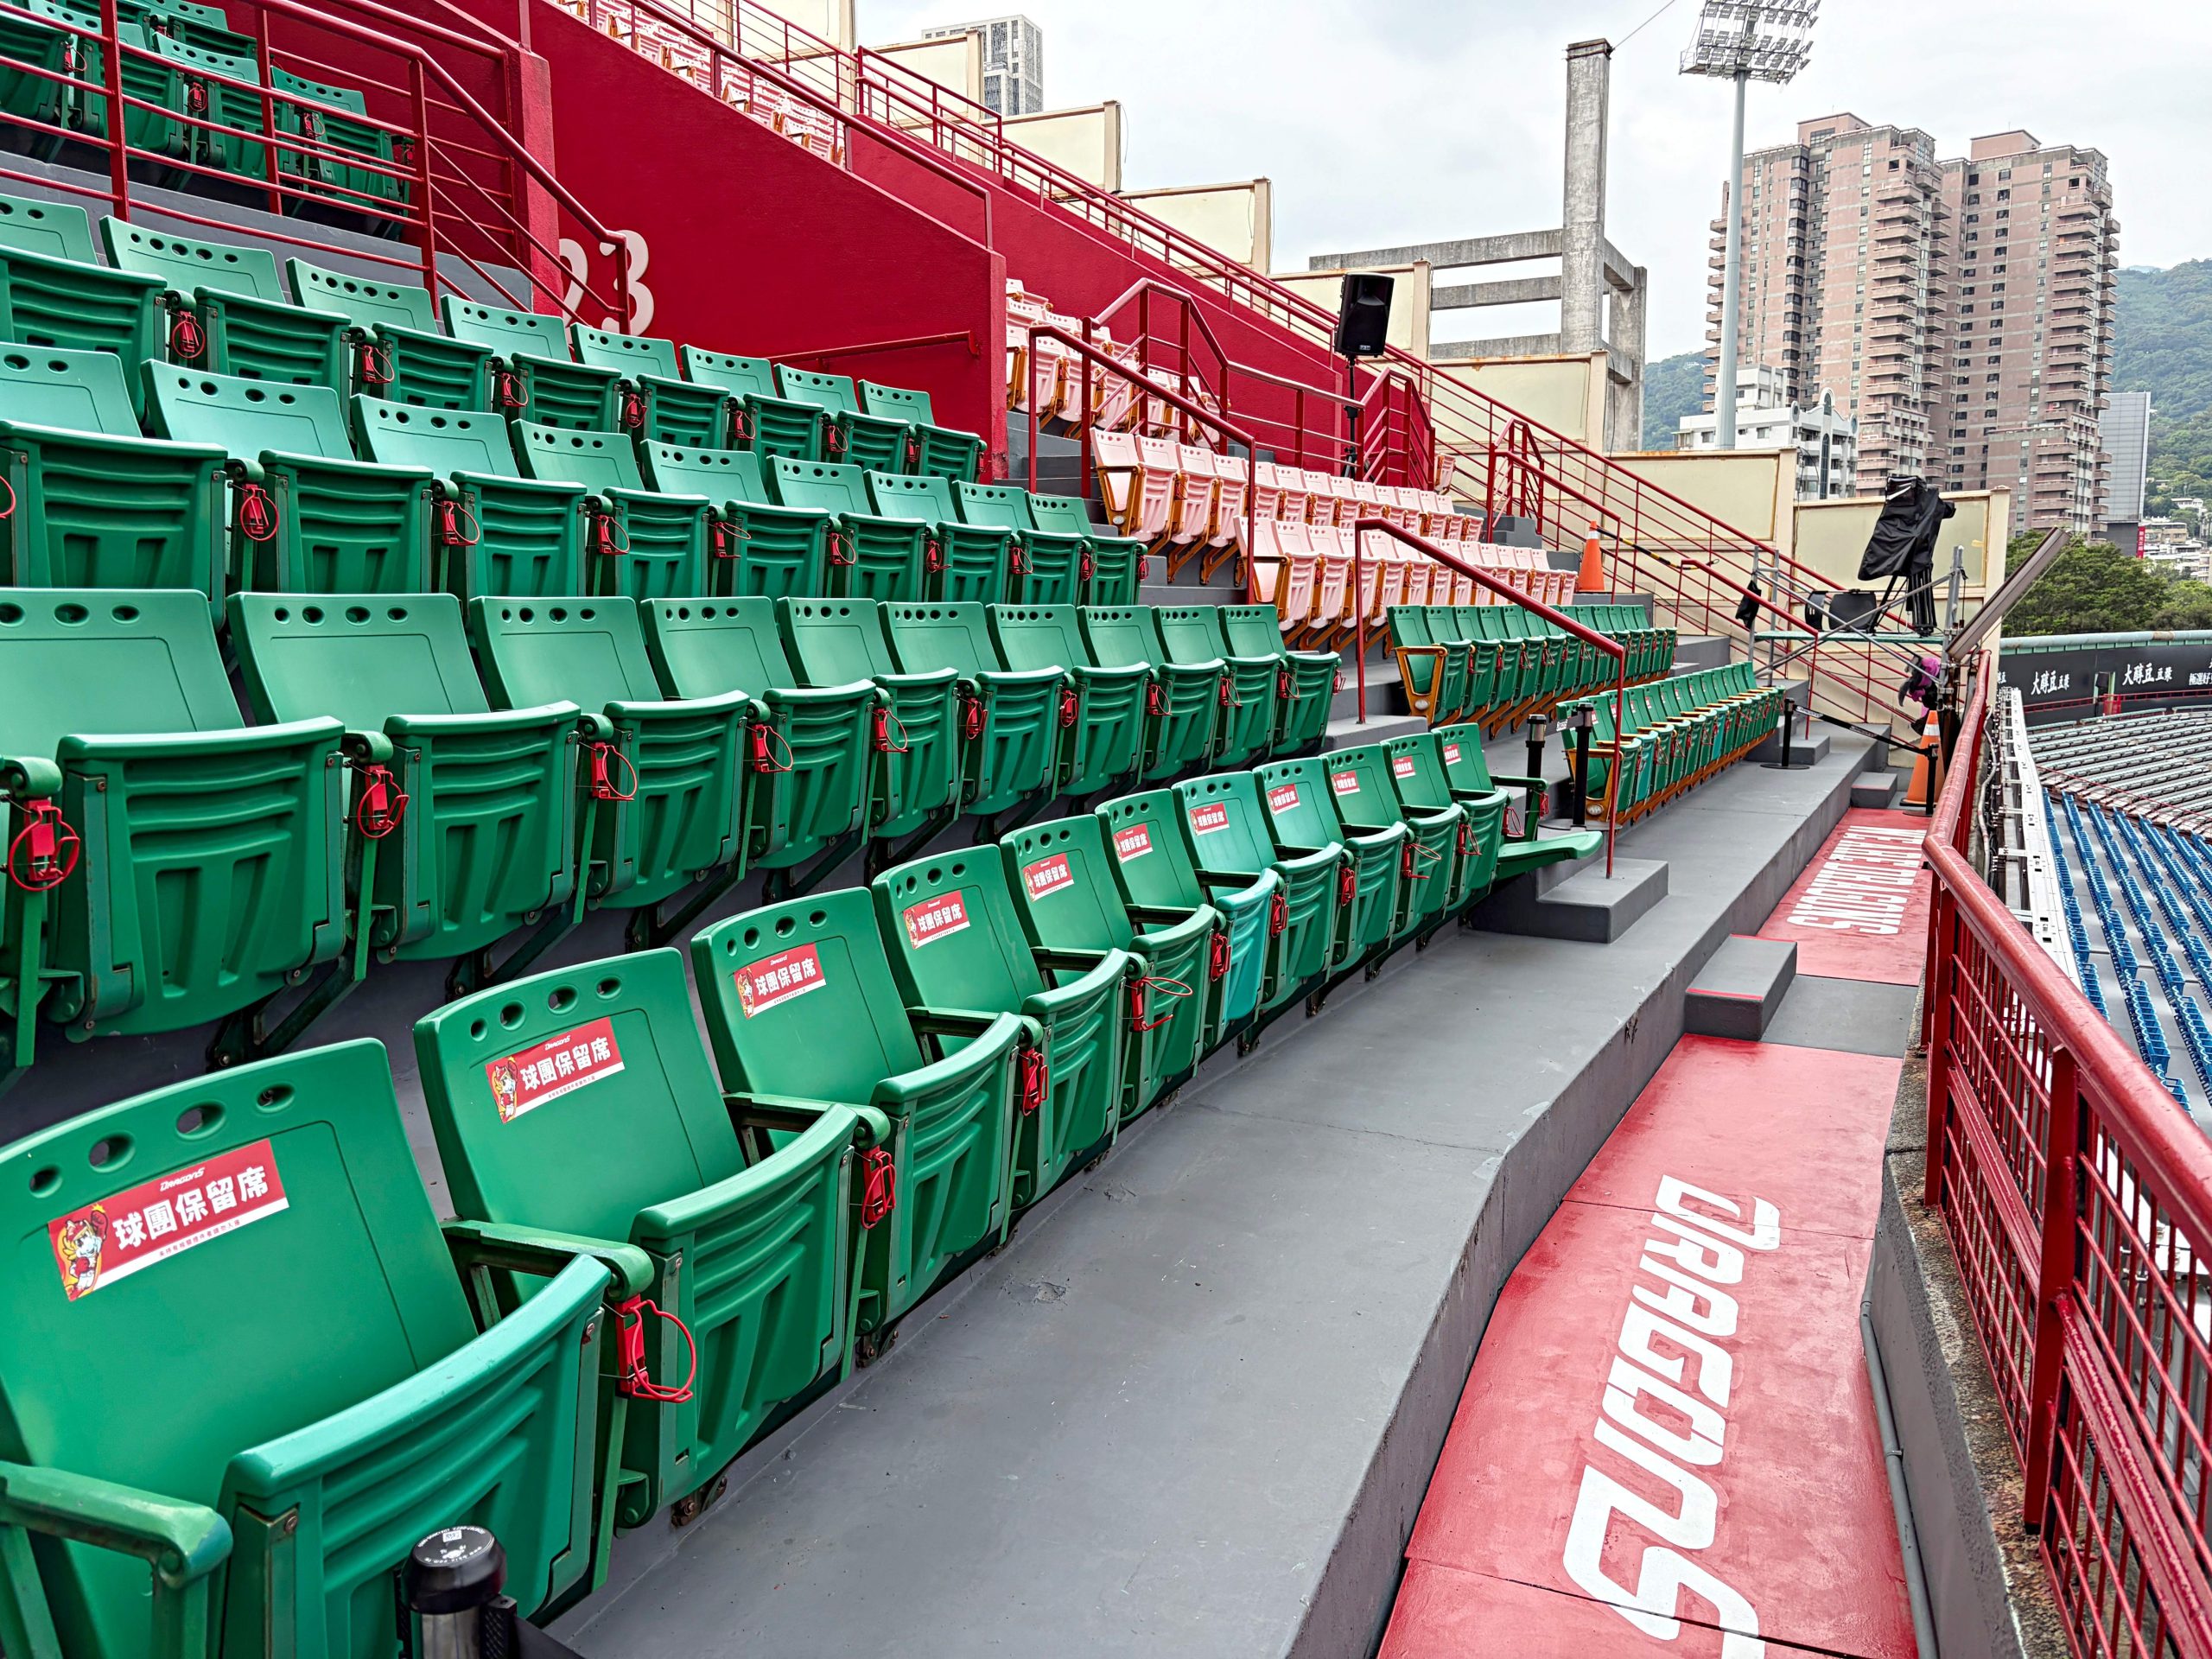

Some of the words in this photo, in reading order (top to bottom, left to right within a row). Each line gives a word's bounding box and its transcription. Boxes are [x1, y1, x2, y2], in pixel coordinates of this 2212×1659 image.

[559, 230, 654, 344] 23
[1828, 839, 1923, 868] ARE
[1843, 825, 1927, 845] WE
[917, 903, 963, 932] 球團保留席
[1786, 861, 1917, 934] DRAGONS
[754, 957, 817, 996] 球團保留席
[520, 1037, 611, 1090] 球團保留席
[112, 1166, 270, 1251] 球團保留席
[1562, 1174, 1780, 1659] DRAGONS
